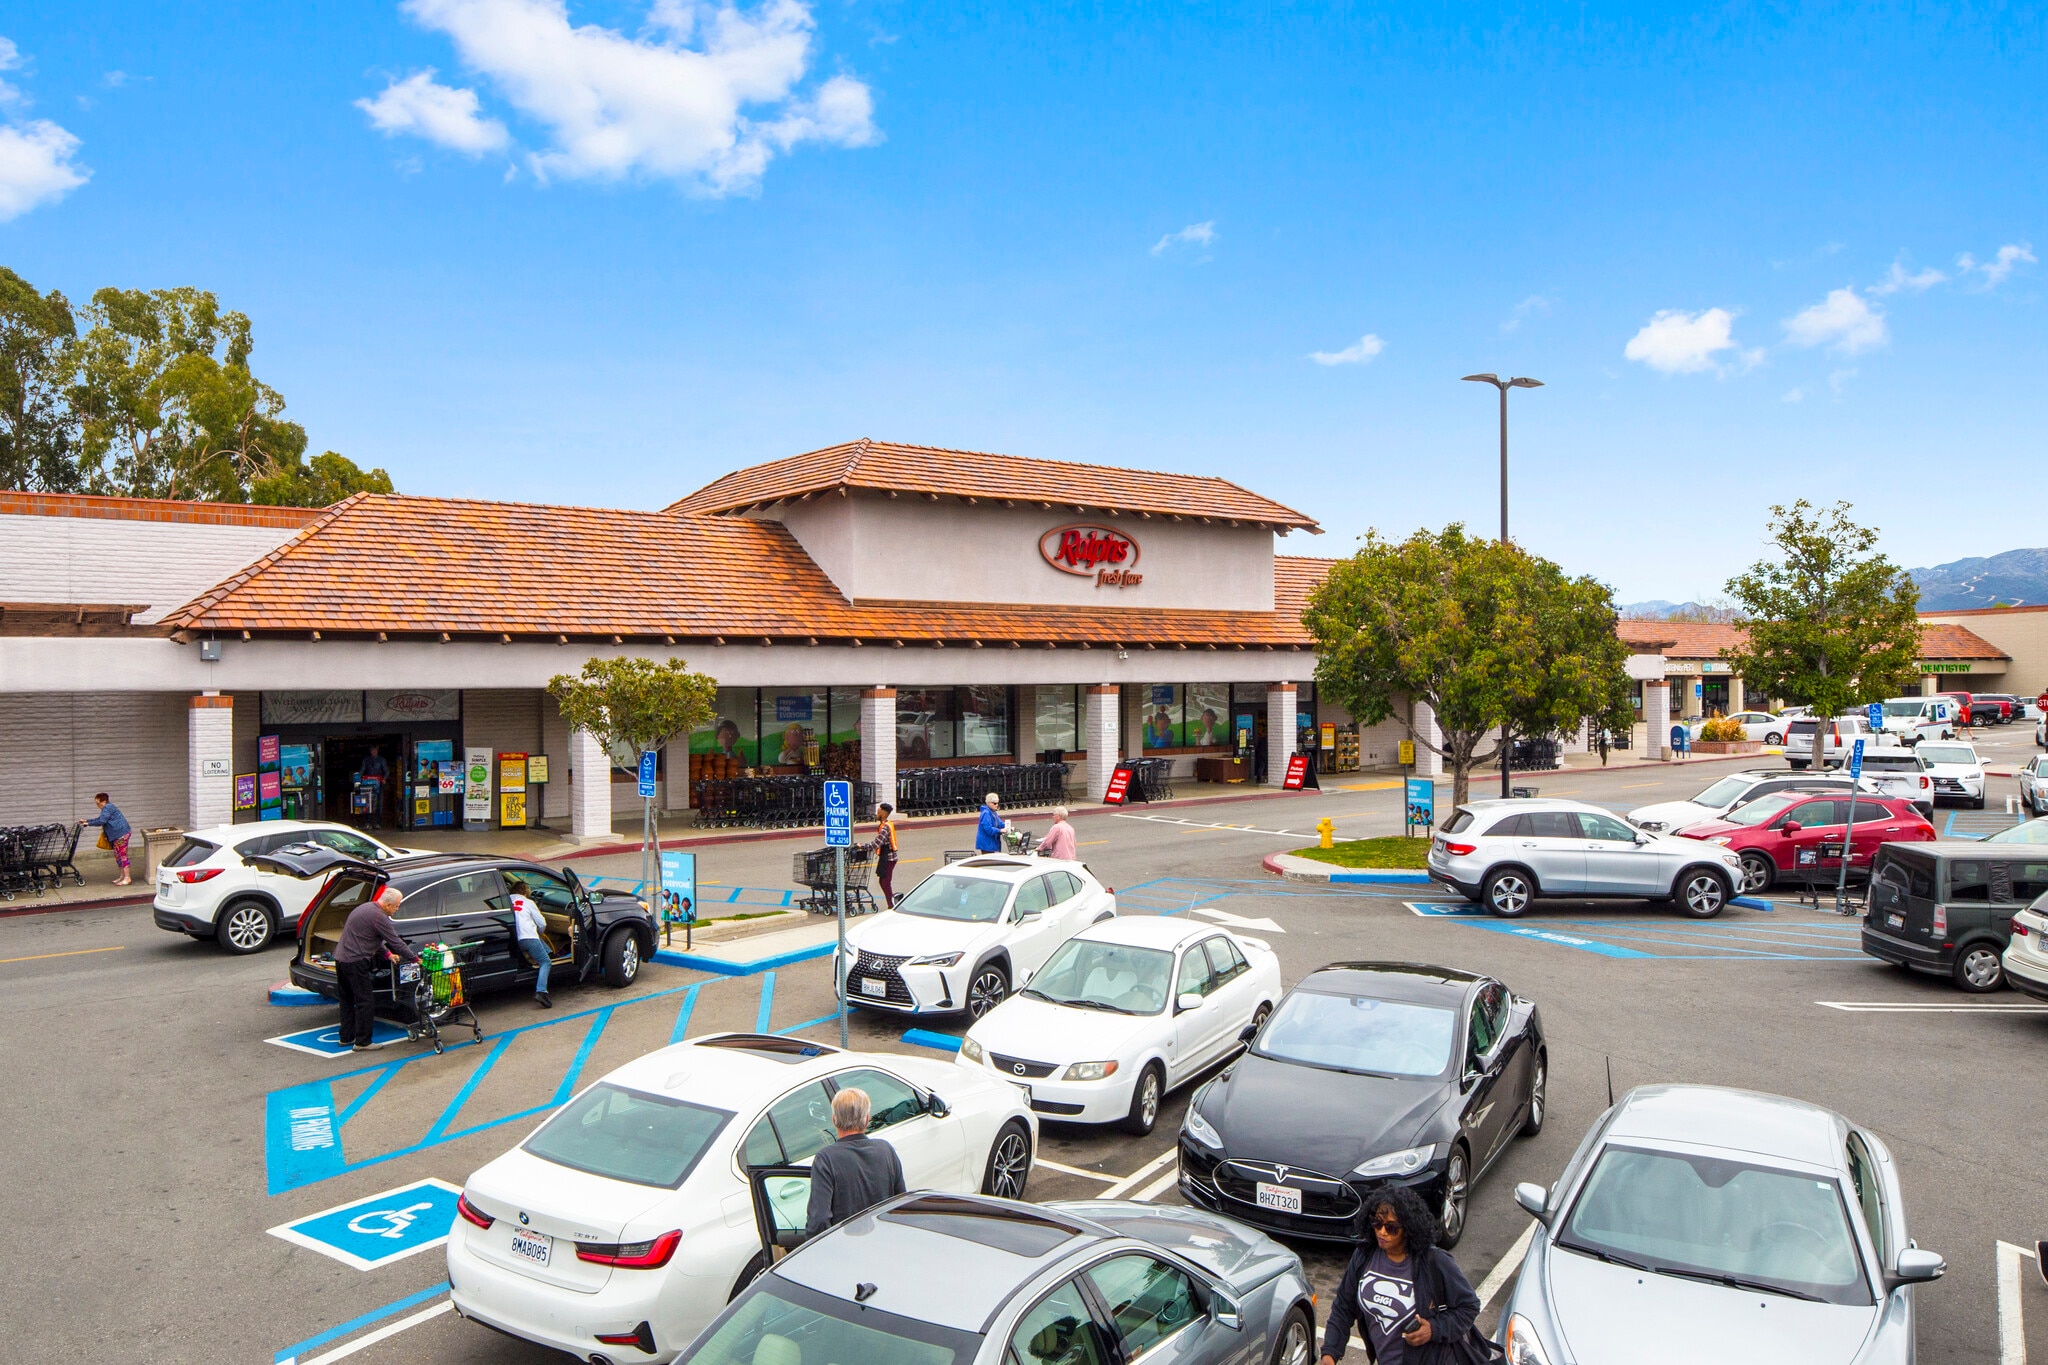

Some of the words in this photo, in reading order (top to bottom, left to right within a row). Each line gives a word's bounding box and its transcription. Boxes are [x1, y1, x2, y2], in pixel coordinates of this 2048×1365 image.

[1054, 530, 1129, 569] Ralphs
[1096, 568, 1121, 588] fresh
[1120, 570, 1143, 588] fare
[1921, 664, 1971, 672] DENTISTRY
[506, 803, 521, 811] KEYS
[826, 807, 848, 816] PARKING
[507, 810, 521, 818] HERE
[830, 817, 844, 826] ONLY
[662, 861, 679, 869] FRESH
[662, 870, 673, 878] FOR
[289, 1106, 330, 1118] NO
[290, 1117, 335, 1151] PARKING
[1265, 1185, 1292, 1196] California
[1259, 1192, 1298, 1210] 8HZT320
[520, 1229, 543, 1243] California
[511, 1237, 547, 1262] 8MAB085
[1373, 1294, 1393, 1307] GIGI
